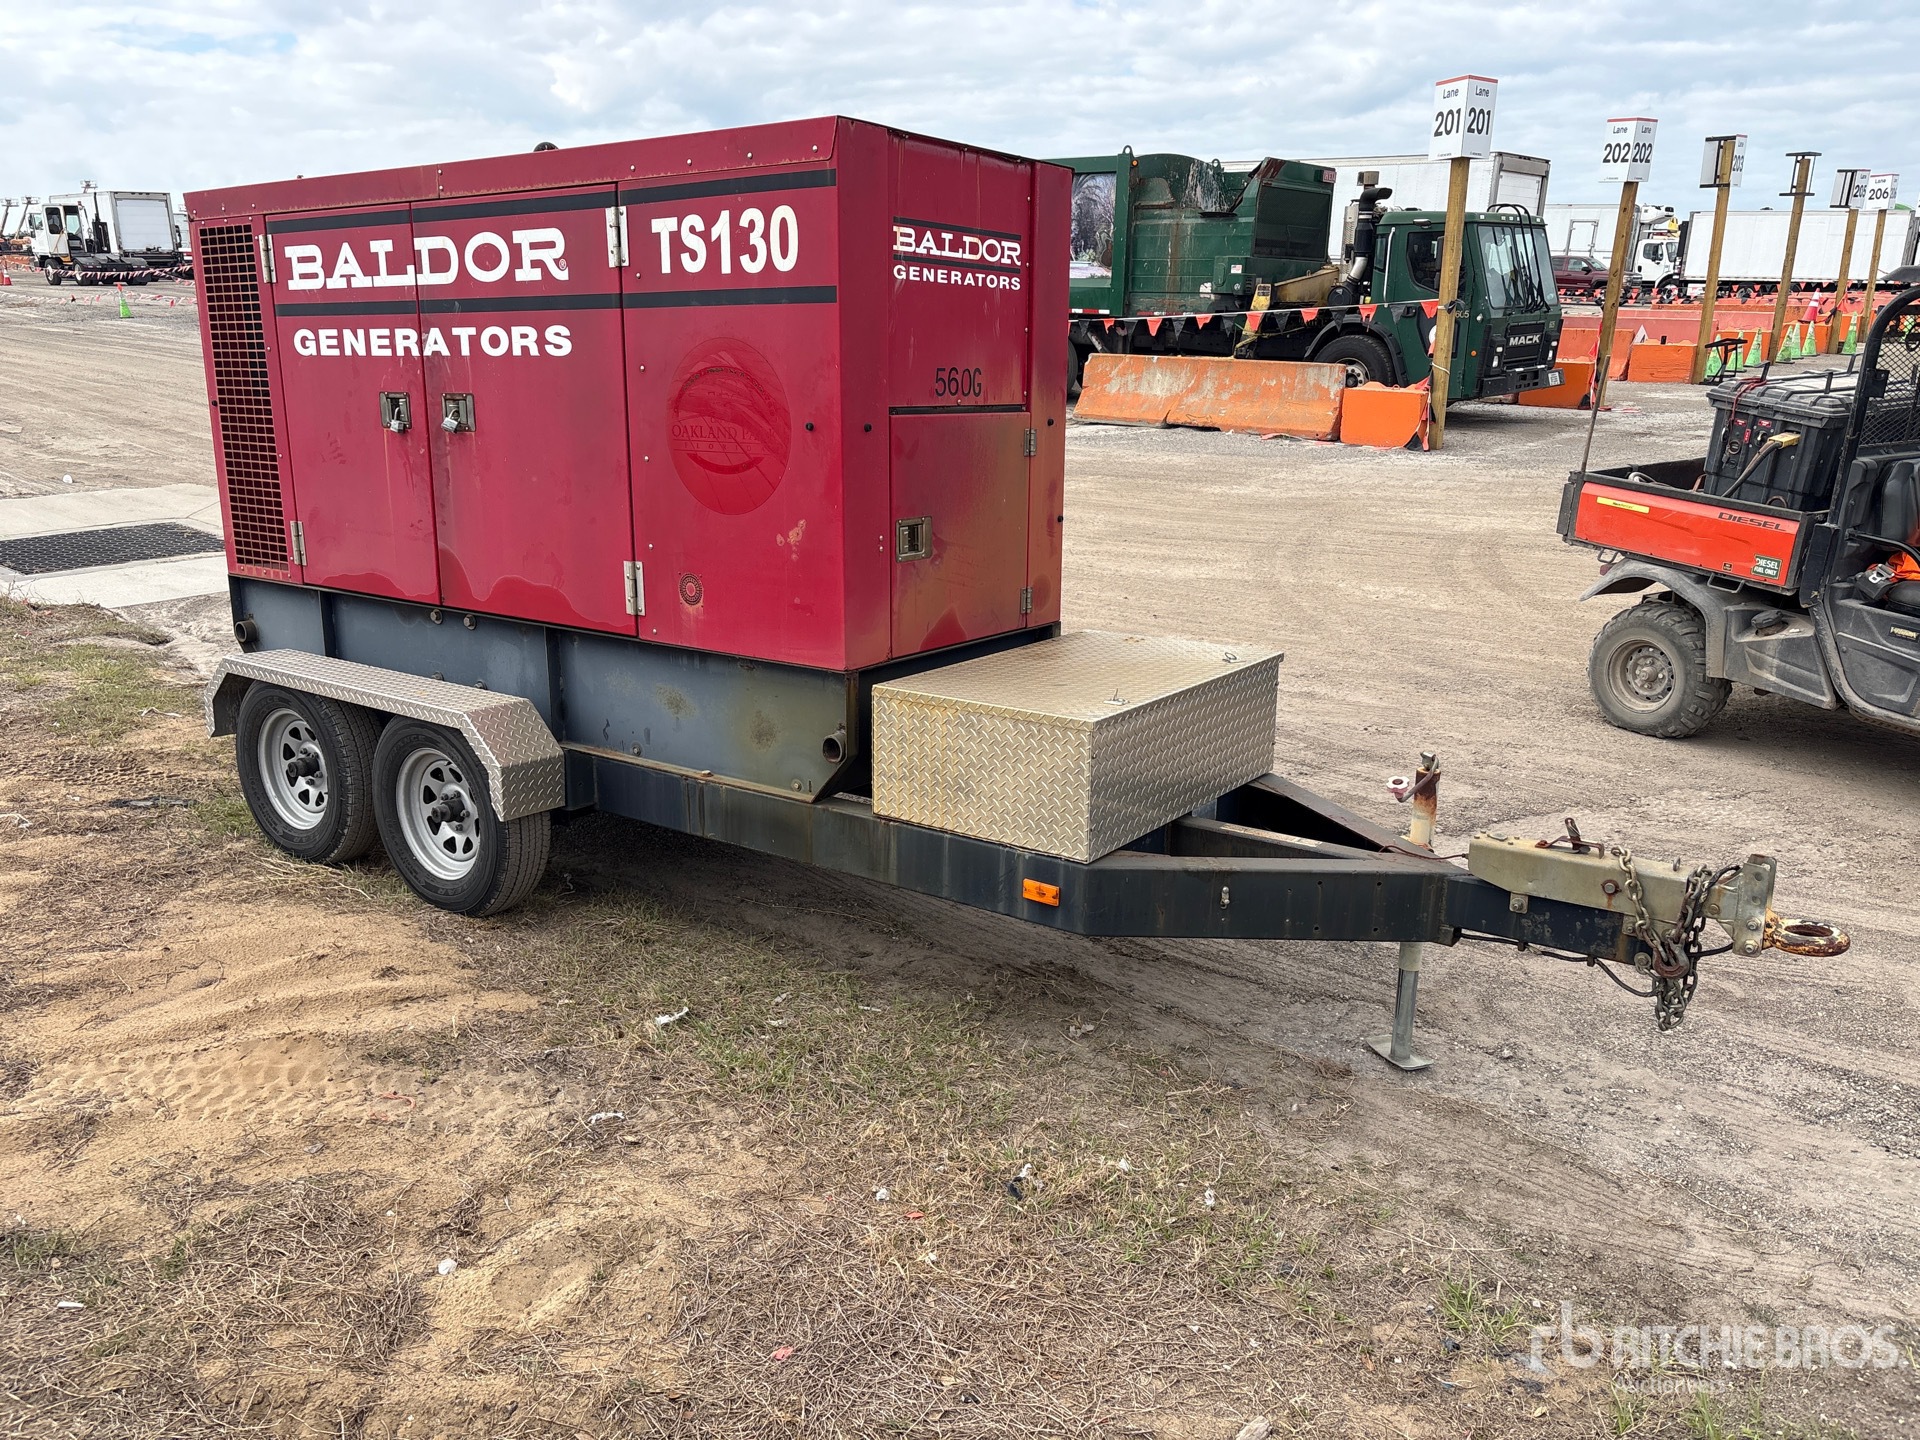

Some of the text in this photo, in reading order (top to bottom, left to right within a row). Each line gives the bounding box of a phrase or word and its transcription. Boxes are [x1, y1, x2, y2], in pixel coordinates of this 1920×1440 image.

[1443, 88, 1459, 99] Lane
[1475, 85, 1490, 97] Lane
[1433, 107, 1462, 138] 201
[1466, 106, 1492, 136] 201
[1612, 125, 1628, 134] Lane
[1602, 142, 1631, 163] 202
[1631, 141, 1653, 163] 202
[1732, 154, 1745, 172] 203
[1853, 184, 1868, 198] 205
[1868, 187, 1889, 201] 206
[650, 204, 799, 275] TS130
[892, 225, 1022, 266] BALDOR
[892, 264, 1021, 291] GENERATORS
[293, 324, 573, 357] GENERATORS
[1509, 334, 1541, 346] MACK
[934, 366, 982, 398] 560G
[671, 424, 738, 440] OAKLAND
[1718, 511, 1787, 532] DIESEL
[1755, 557, 1779, 570] DIESEL
